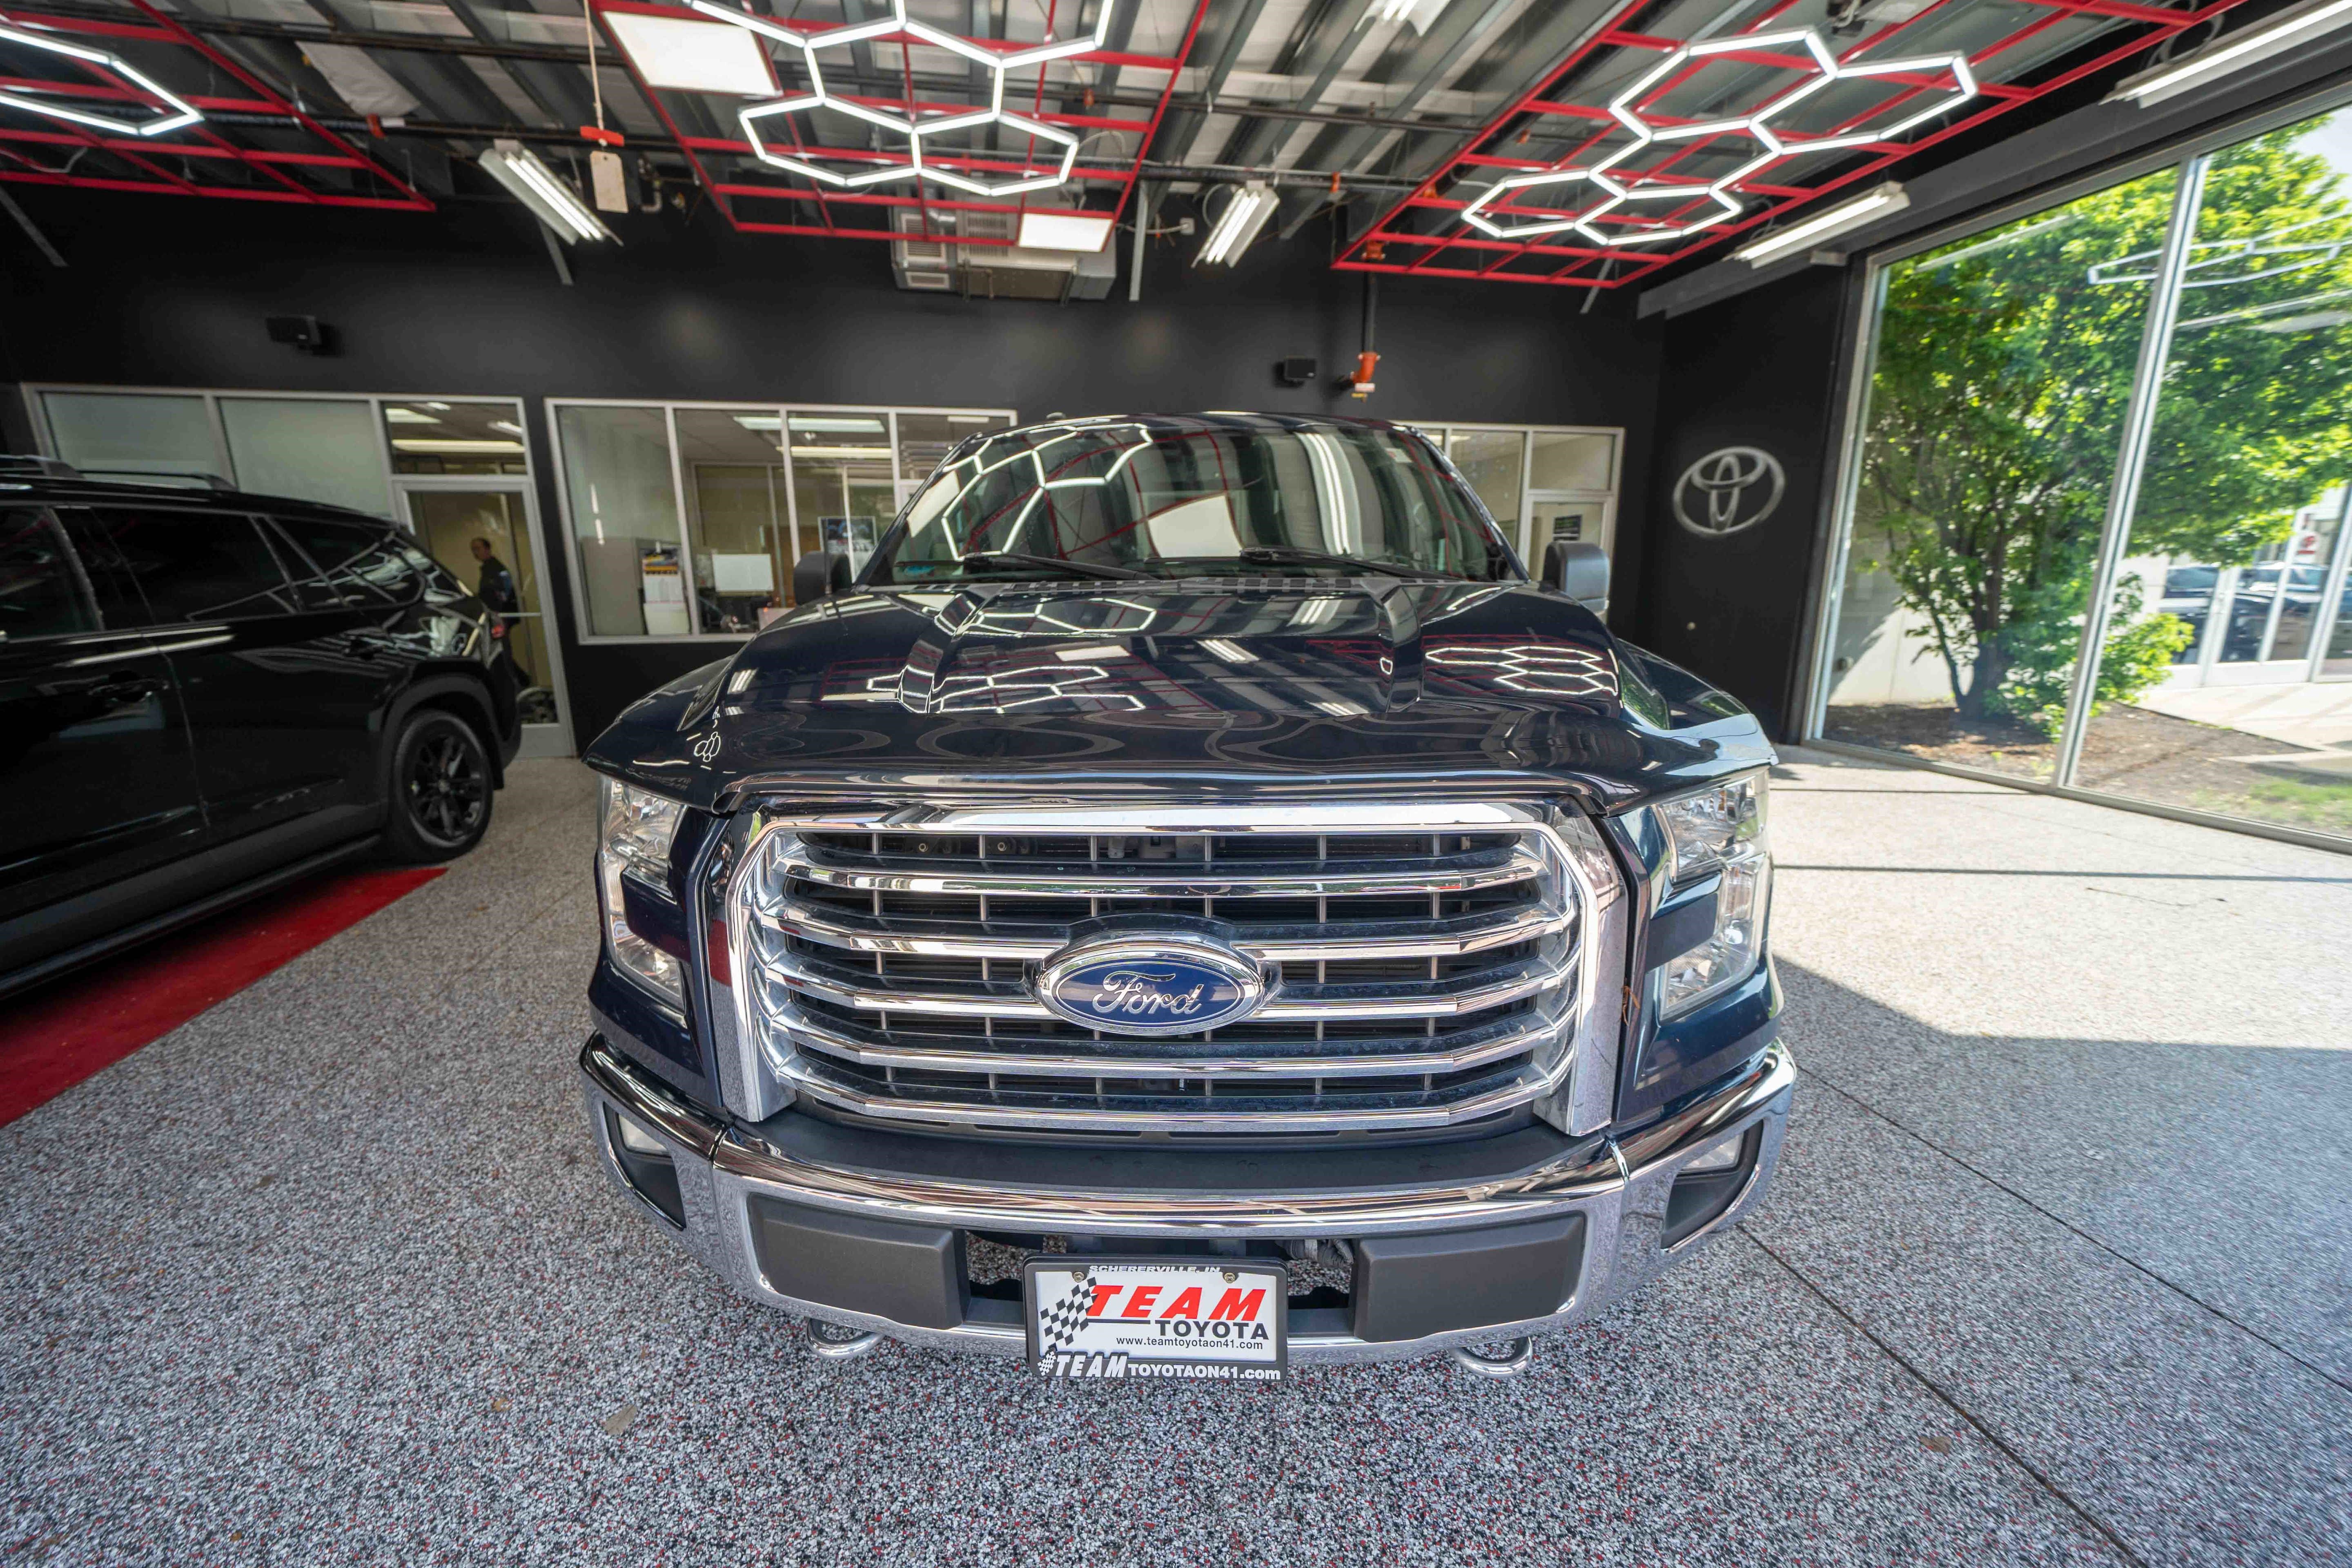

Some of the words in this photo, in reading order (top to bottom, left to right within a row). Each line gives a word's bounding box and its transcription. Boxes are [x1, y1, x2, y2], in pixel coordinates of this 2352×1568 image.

[1092, 970, 1204, 1014] Ford
[1087, 1285, 1266, 1321] TEAM
[1155, 1319, 1270, 1340] TOYOTA
[1116, 1336, 1263, 1350] www.teamtoyotaon41.com
[1056, 1354, 1129, 1378] TEAM
[1128, 1363, 1281, 1380] TOYOTAON41.com
